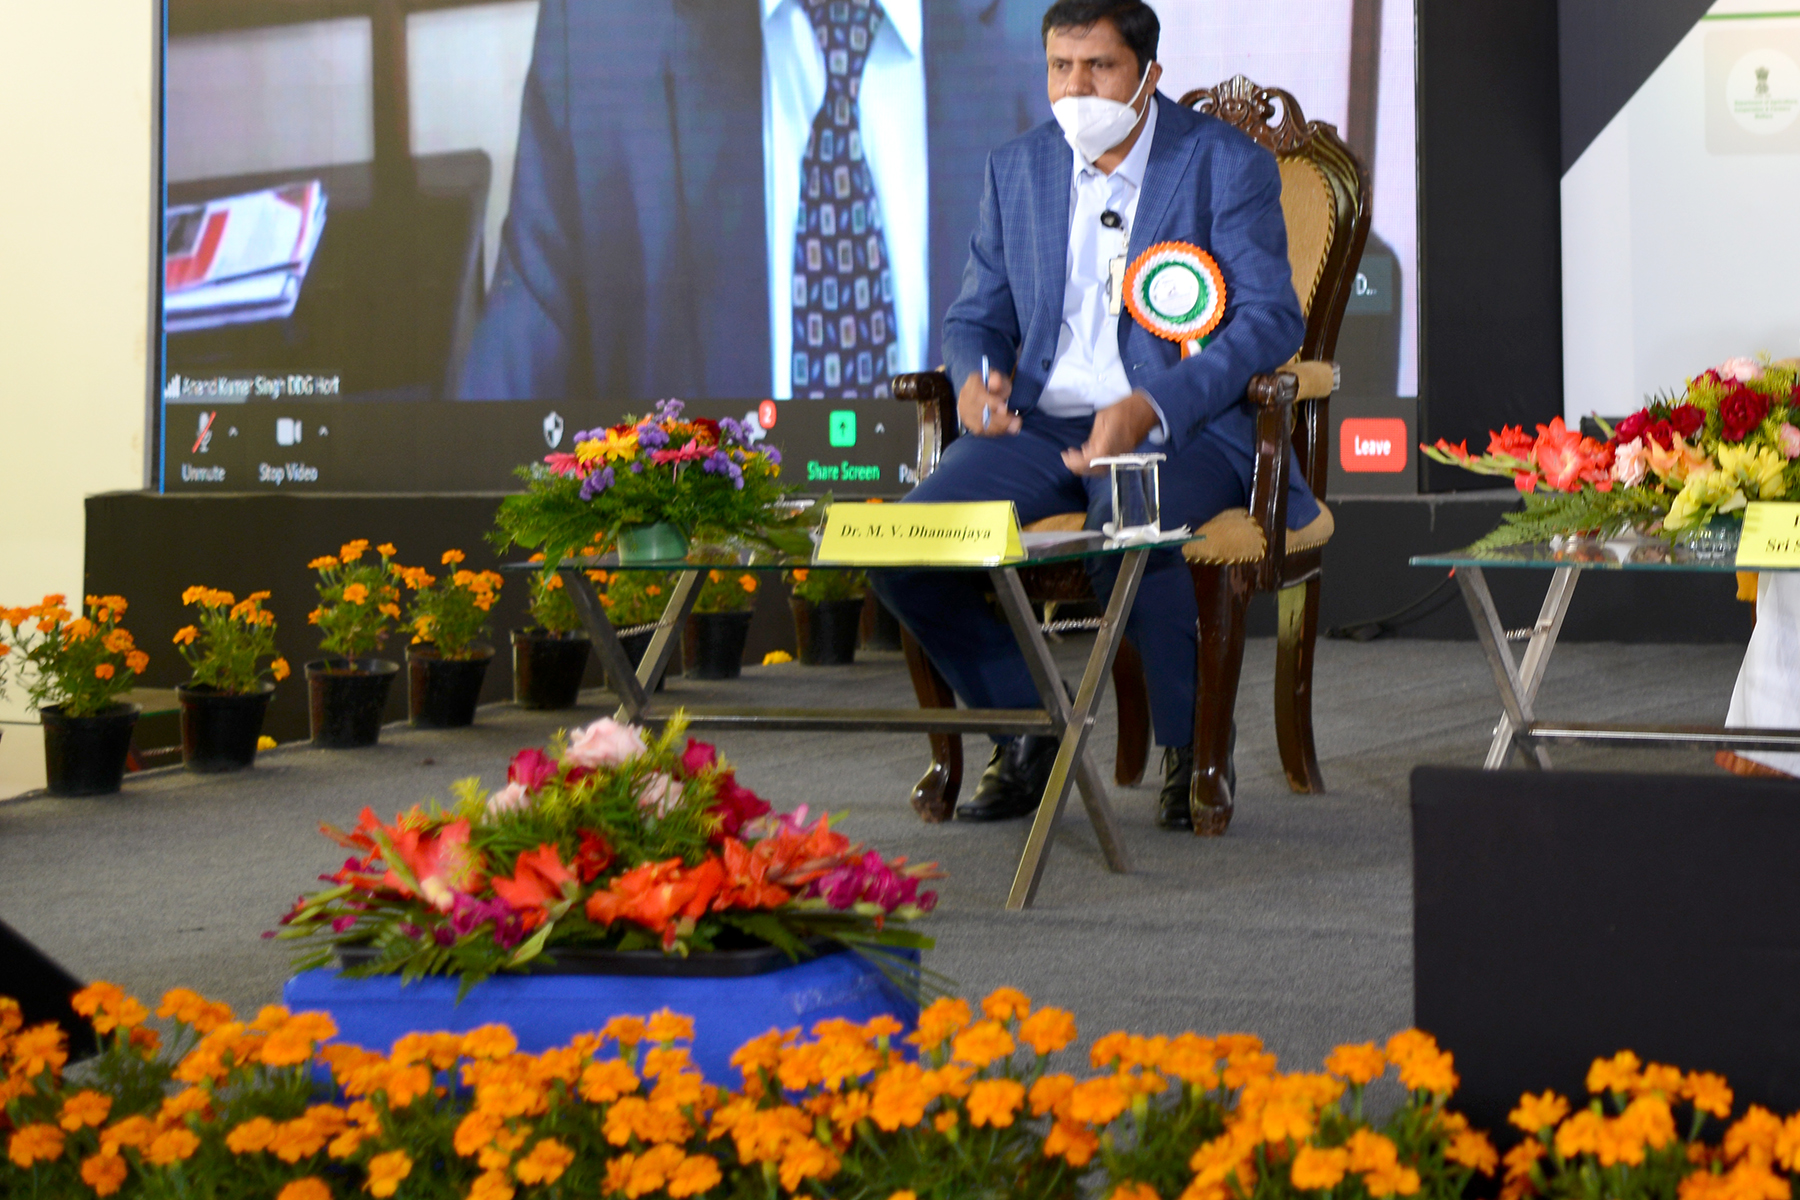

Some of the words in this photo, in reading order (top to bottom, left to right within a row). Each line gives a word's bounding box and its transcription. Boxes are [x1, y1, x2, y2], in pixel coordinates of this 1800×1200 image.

[1355, 435, 1392, 457] Leave
[181, 463, 226, 483] Unmute
[259, 462, 284, 486] Stop
[286, 463, 319, 483] Video
[807, 460, 840, 481] Share
[842, 461, 880, 481] Screen
[840, 524, 861, 538] Dr.
[866, 524, 884, 538] M.
[891, 524, 904, 538] V.
[908, 524, 991, 542] Dhananjaya
[1765, 539, 1789, 553] Sri
